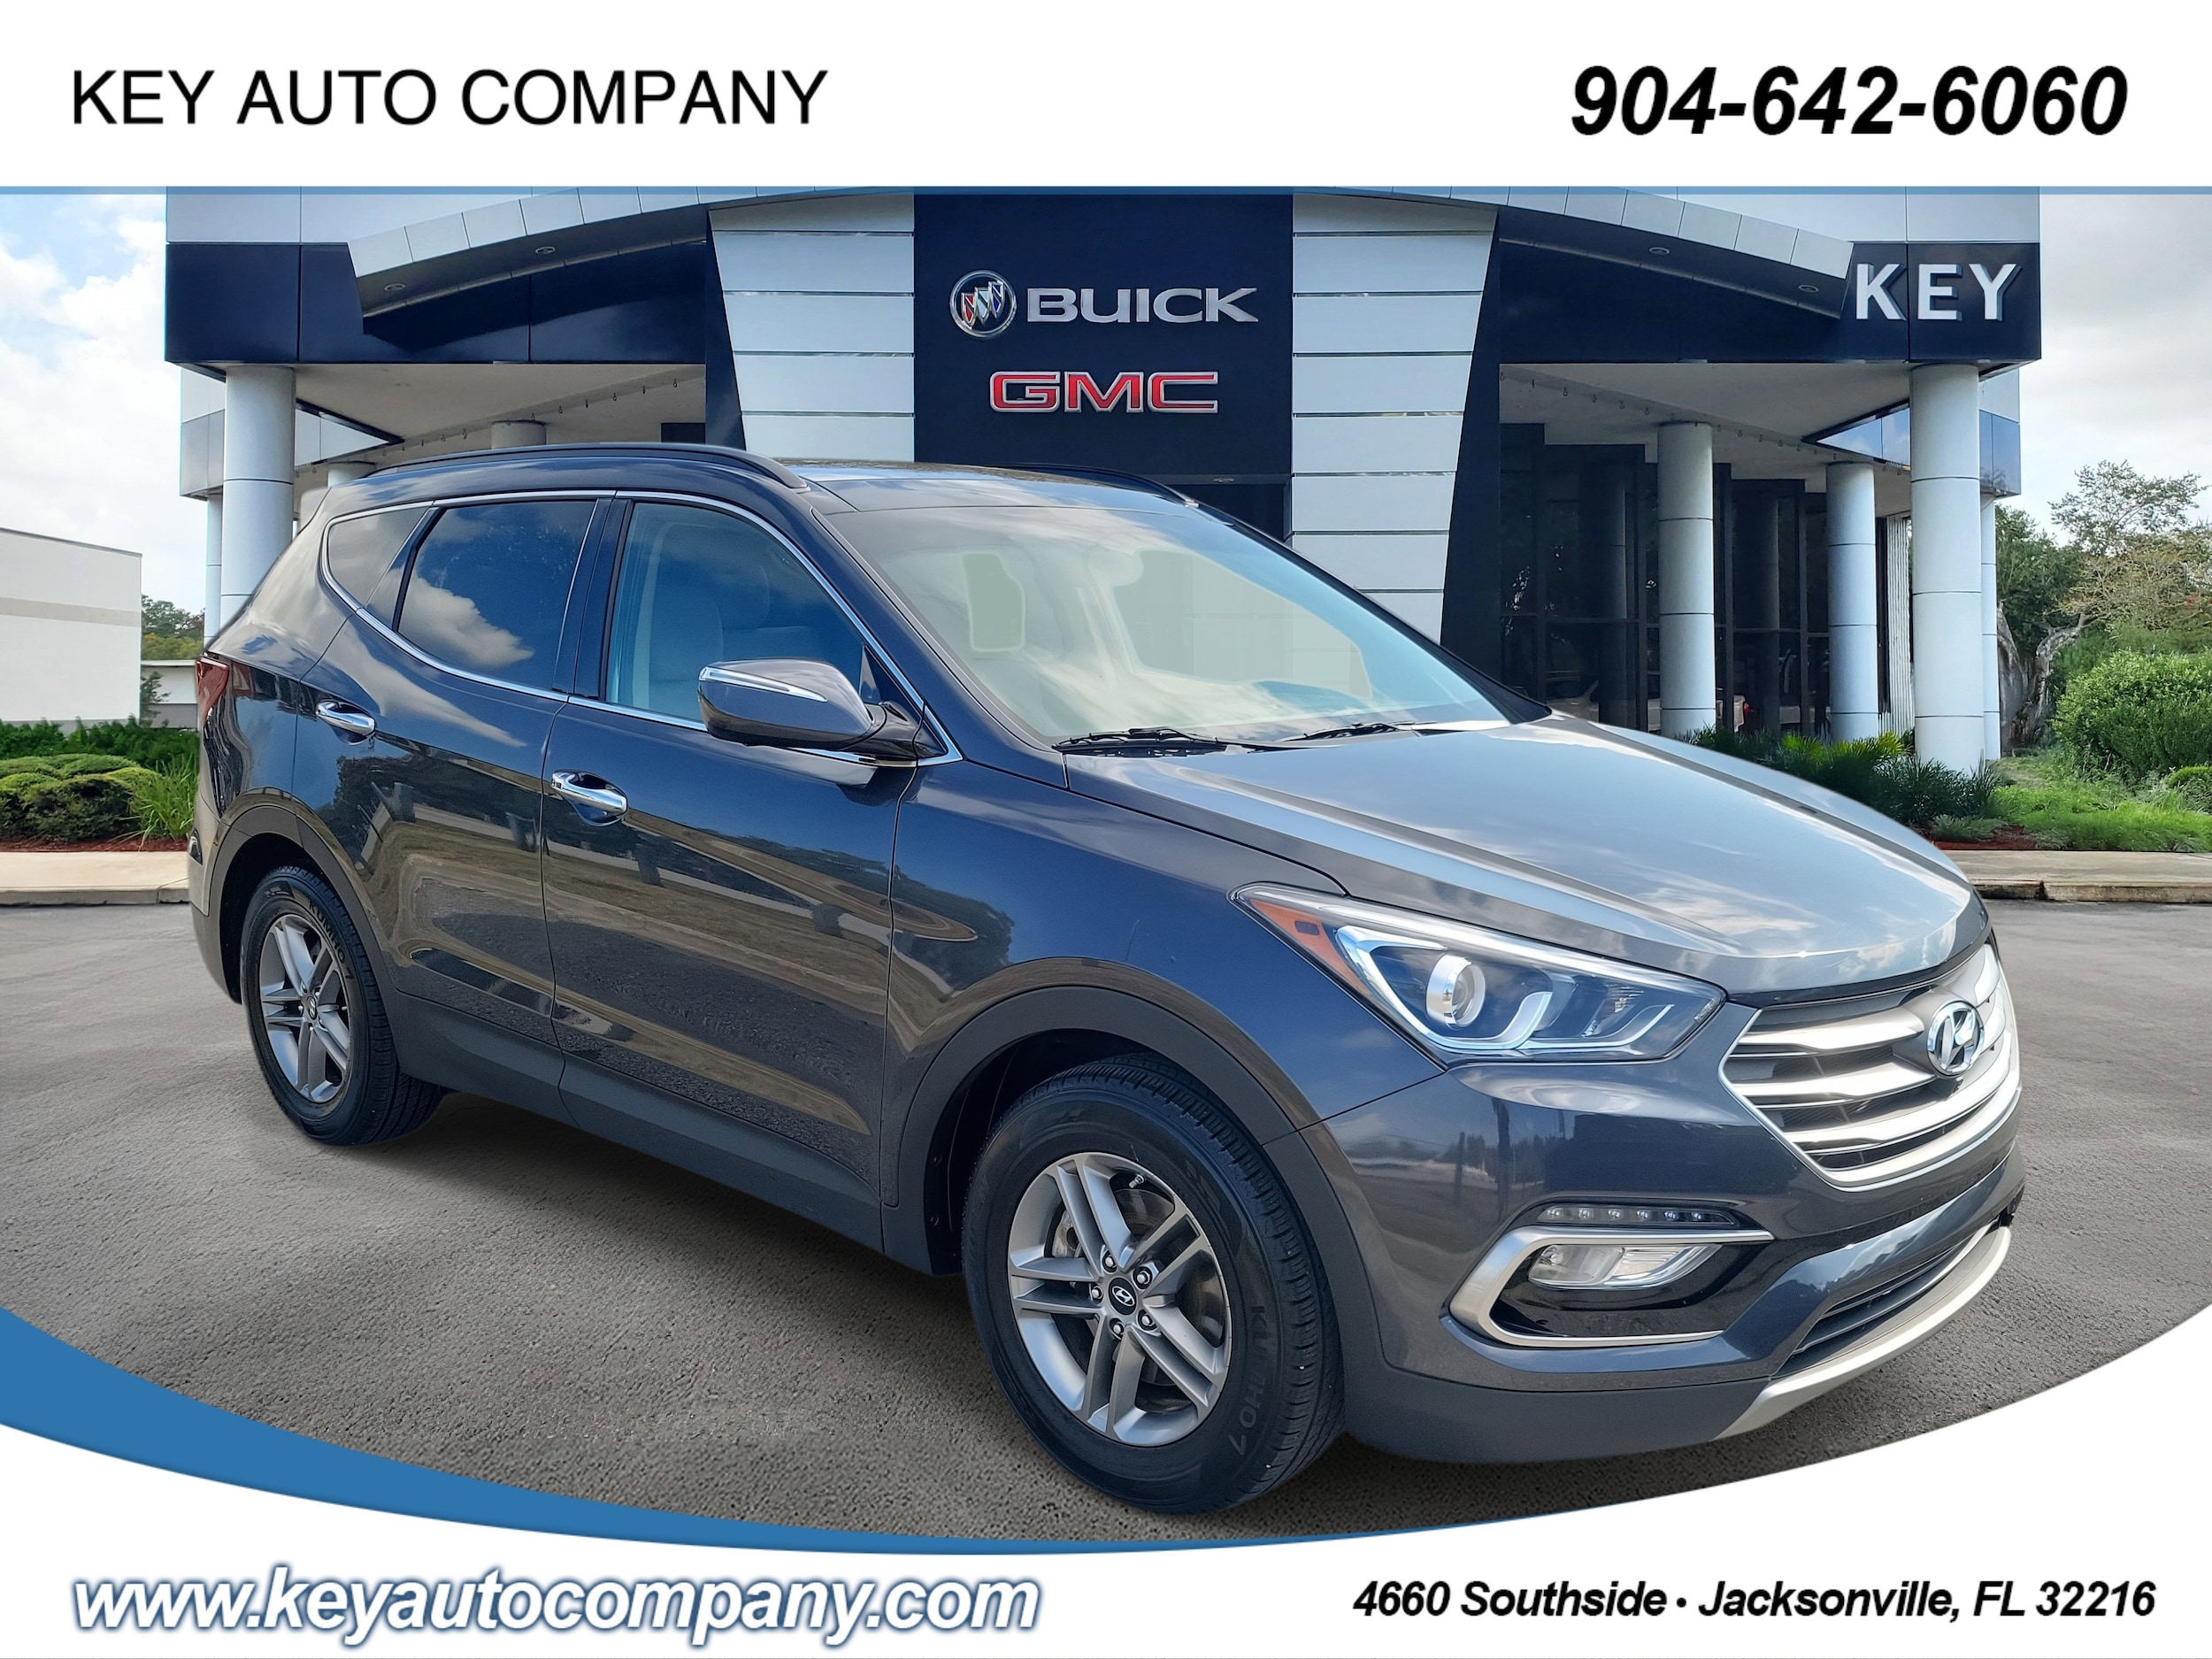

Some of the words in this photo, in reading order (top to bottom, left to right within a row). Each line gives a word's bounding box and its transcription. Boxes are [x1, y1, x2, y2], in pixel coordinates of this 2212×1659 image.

[1026, 287, 1258, 324] BUICK
[1855, 263, 2021, 321] KEY
[989, 372, 1218, 414] GMC
